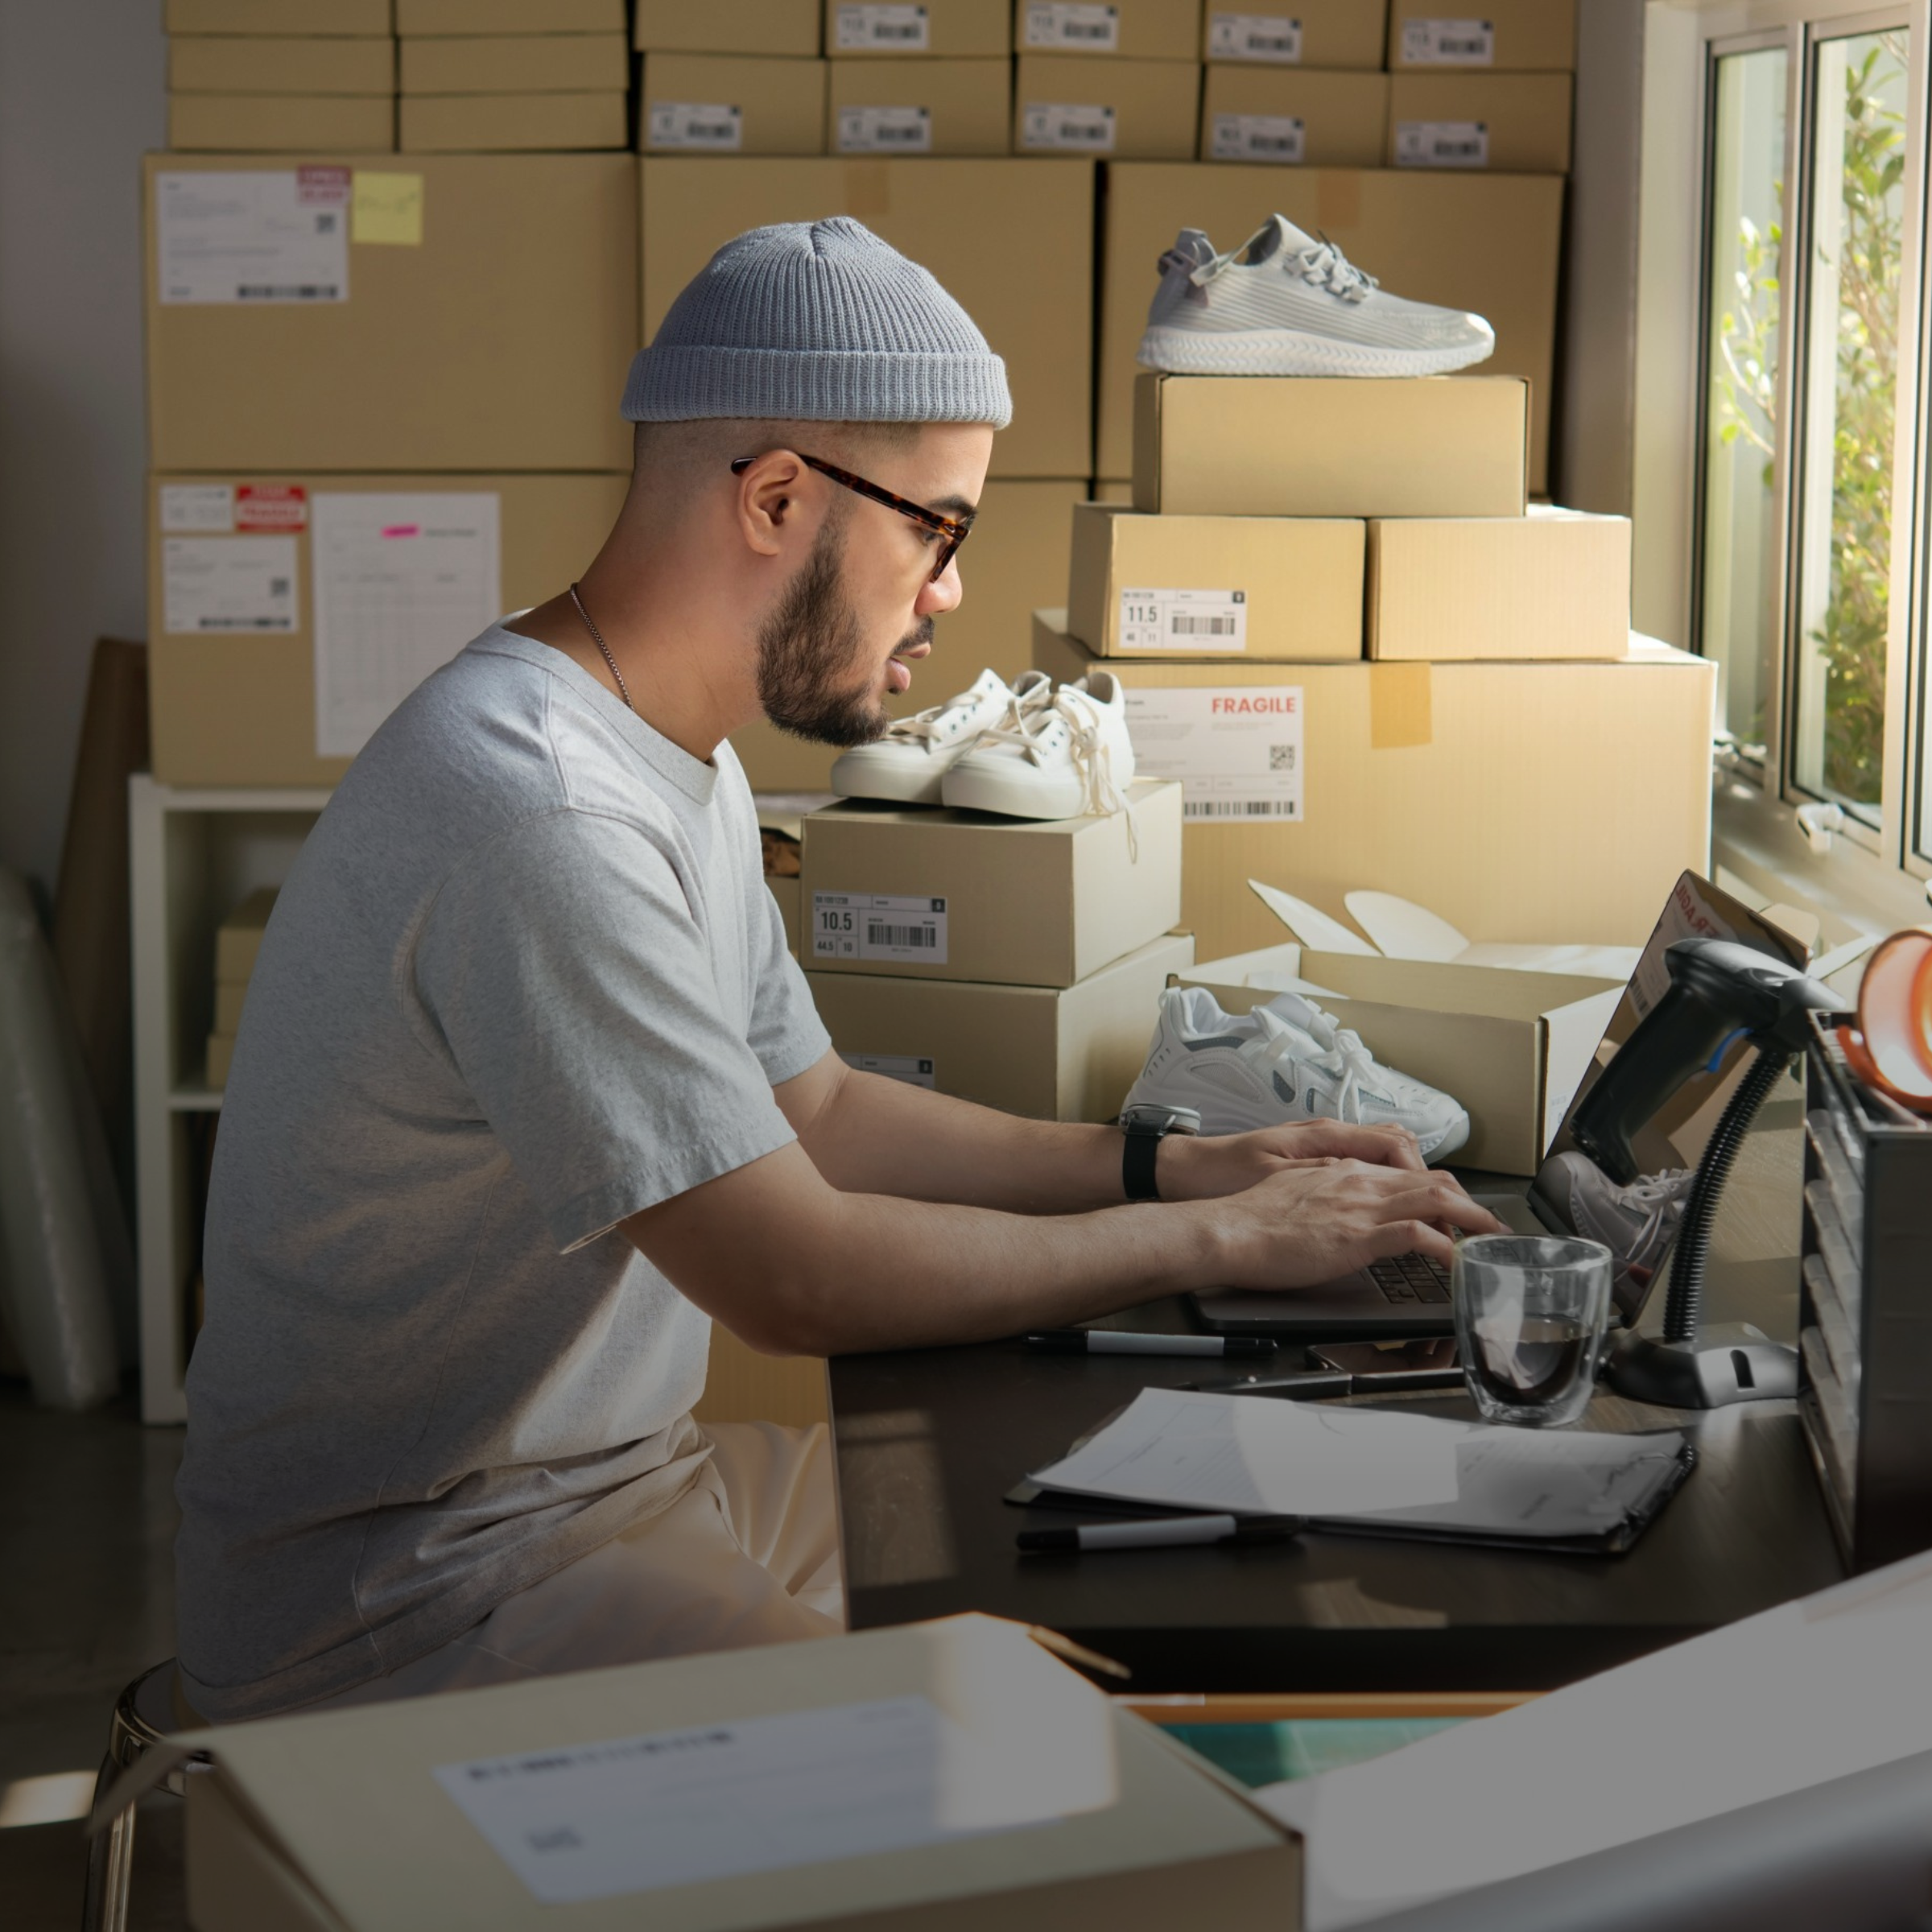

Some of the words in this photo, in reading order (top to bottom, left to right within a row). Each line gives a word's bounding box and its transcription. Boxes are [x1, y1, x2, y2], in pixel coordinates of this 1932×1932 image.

[1129, 606, 1158, 622] 11.5
[1212, 697, 1296, 713] FRAGILE
[821, 911, 852, 931] 10.5
[817, 940, 834, 952] 44.5
[844, 942, 852, 952] 10
